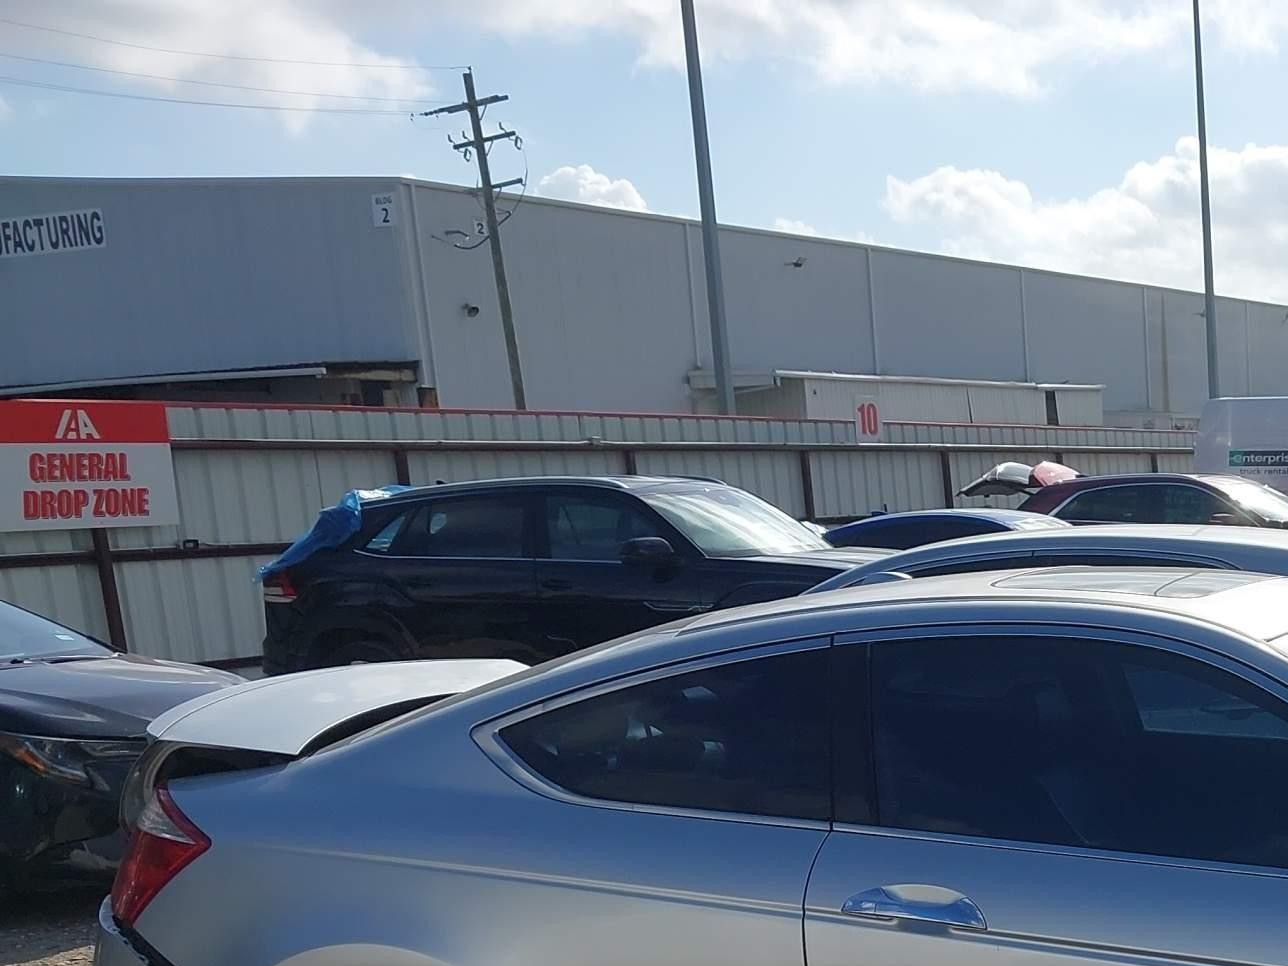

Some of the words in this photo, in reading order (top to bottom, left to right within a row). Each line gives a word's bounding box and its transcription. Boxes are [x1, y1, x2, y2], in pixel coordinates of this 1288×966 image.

[381, 207, 390, 223] 2
[477, 222, 485, 234] 2
[0, 211, 104, 256] FACTURING
[857, 403, 878, 435] 10
[29, 452, 131, 483] GENERAL
[23, 489, 89, 521] DROP
[92, 487, 150, 518] ZONE
